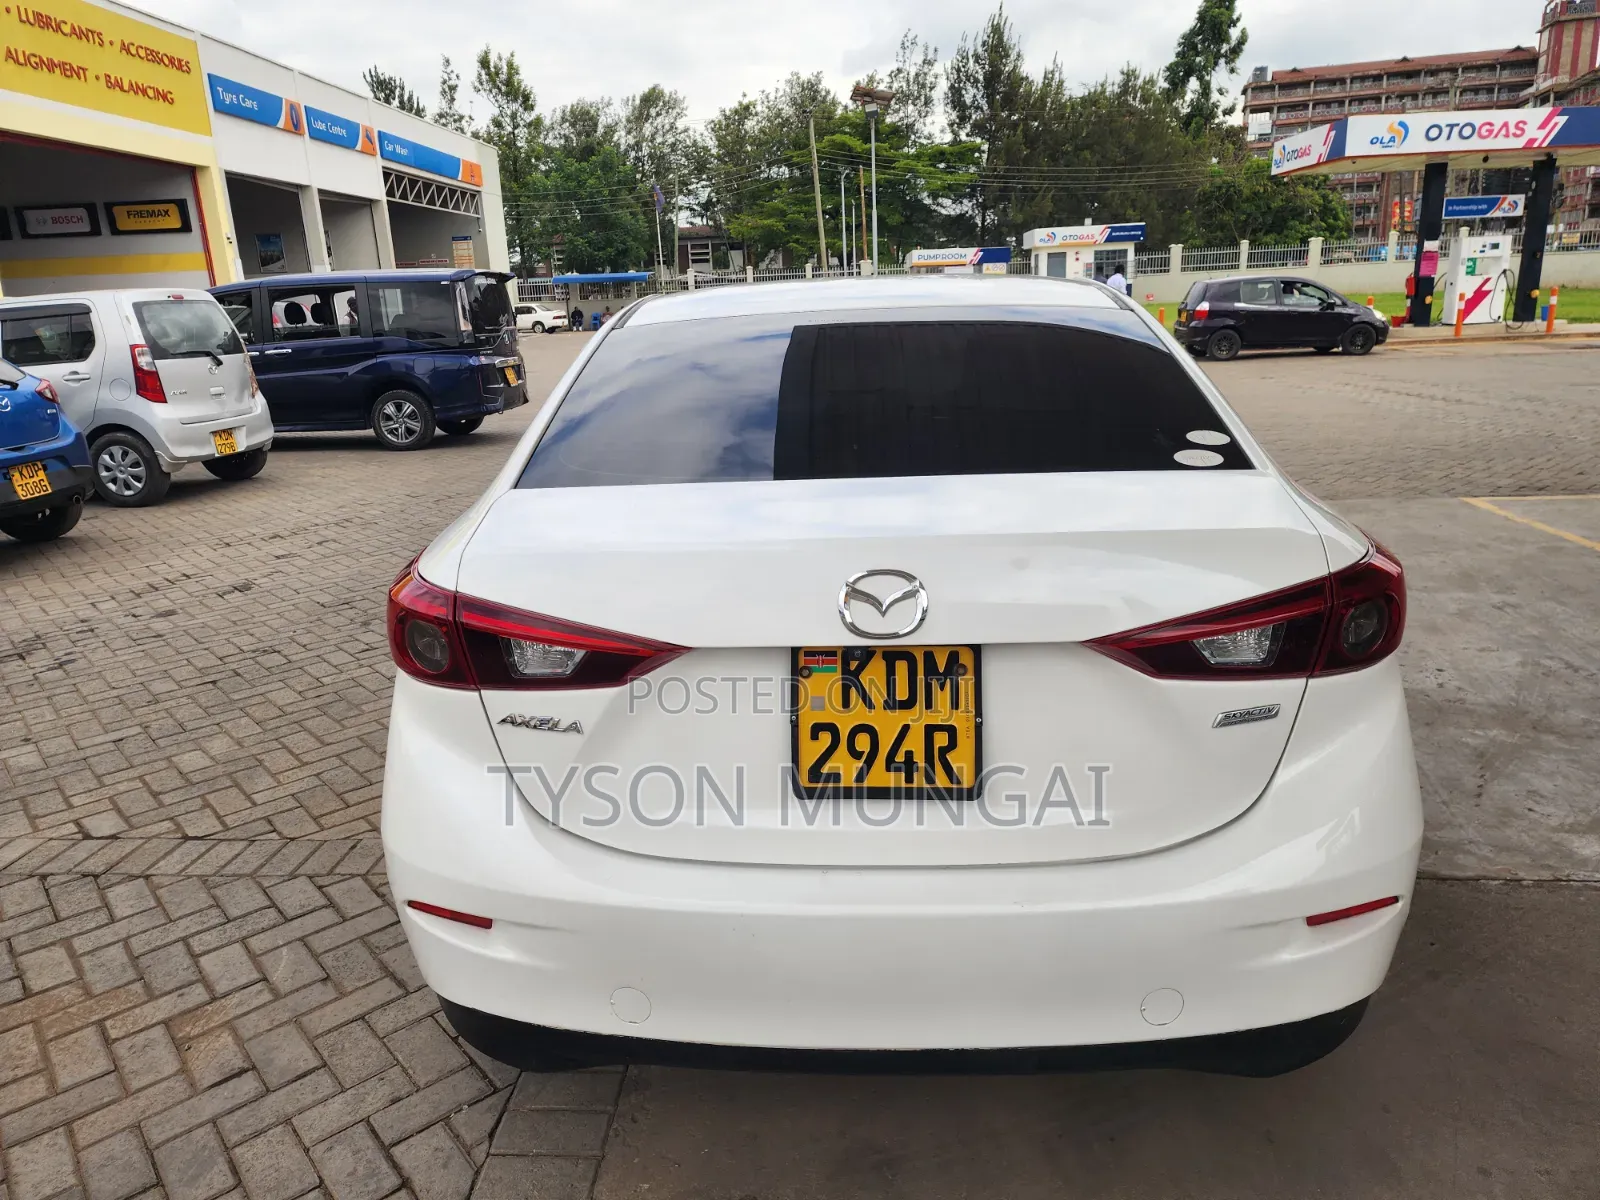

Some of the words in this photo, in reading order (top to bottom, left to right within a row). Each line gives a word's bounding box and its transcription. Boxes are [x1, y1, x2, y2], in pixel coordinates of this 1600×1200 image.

[16, 5, 105, 47] LUBRICANTS
[119, 39, 192, 74] ACCESSORIES
[4, 46, 88, 82] ALIGNMENT
[104, 72, 175, 105] BALANCING
[216, 86, 237, 105] Tyre
[239, 92, 259, 111] Care
[311, 117, 327, 131] Lube
[328, 122, 347, 138] Centre
[1425, 119, 1528, 142] OTOGAS
[384, 140, 394, 152] Car
[1369, 135, 1396, 145] OLA
[1286, 144, 1312, 162] OTOGAS
[51, 215, 84, 225] BOSCH
[126, 209, 171, 219] FREMAX
[1061, 233, 1096, 241] OTOGAS
[17, 462, 41, 481] KDP
[17, 479, 50, 498] 308G
[841, 649, 960, 711] KDM
[1224, 706, 1275, 720] SKYACTIV
[496, 713, 584, 735] AXELA
[807, 722, 962, 785] 294R
